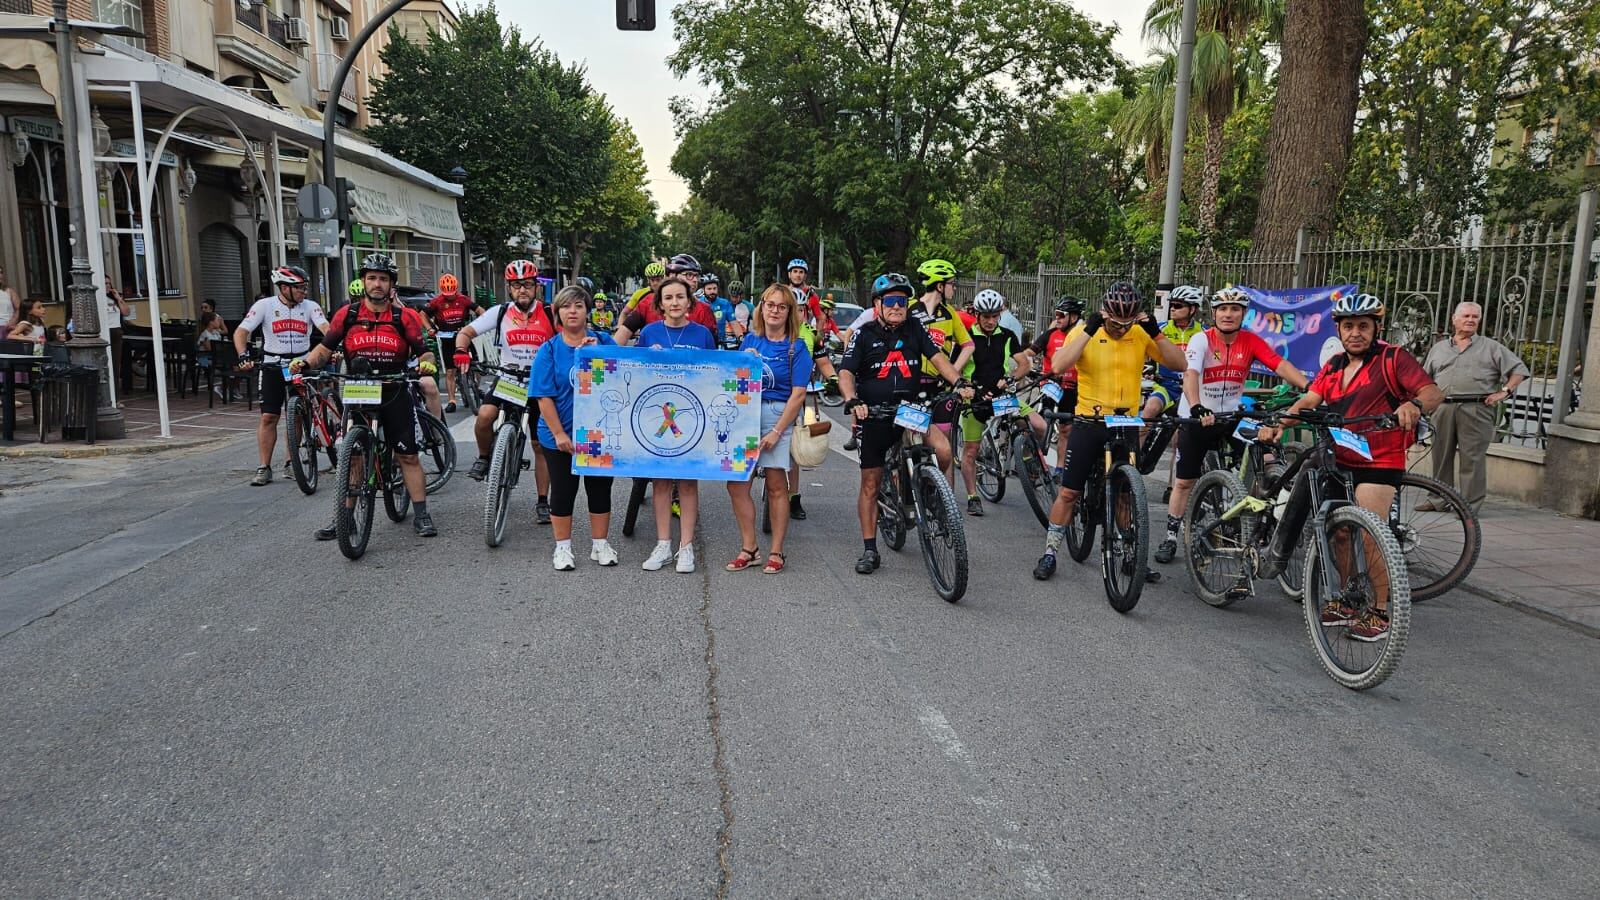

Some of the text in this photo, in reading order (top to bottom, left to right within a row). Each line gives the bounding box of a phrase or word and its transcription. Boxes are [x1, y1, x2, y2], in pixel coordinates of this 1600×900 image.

[1242, 308, 1322, 335] AUTISMO
[353, 336, 365, 345] LA
[1204, 371, 1215, 380] LA
